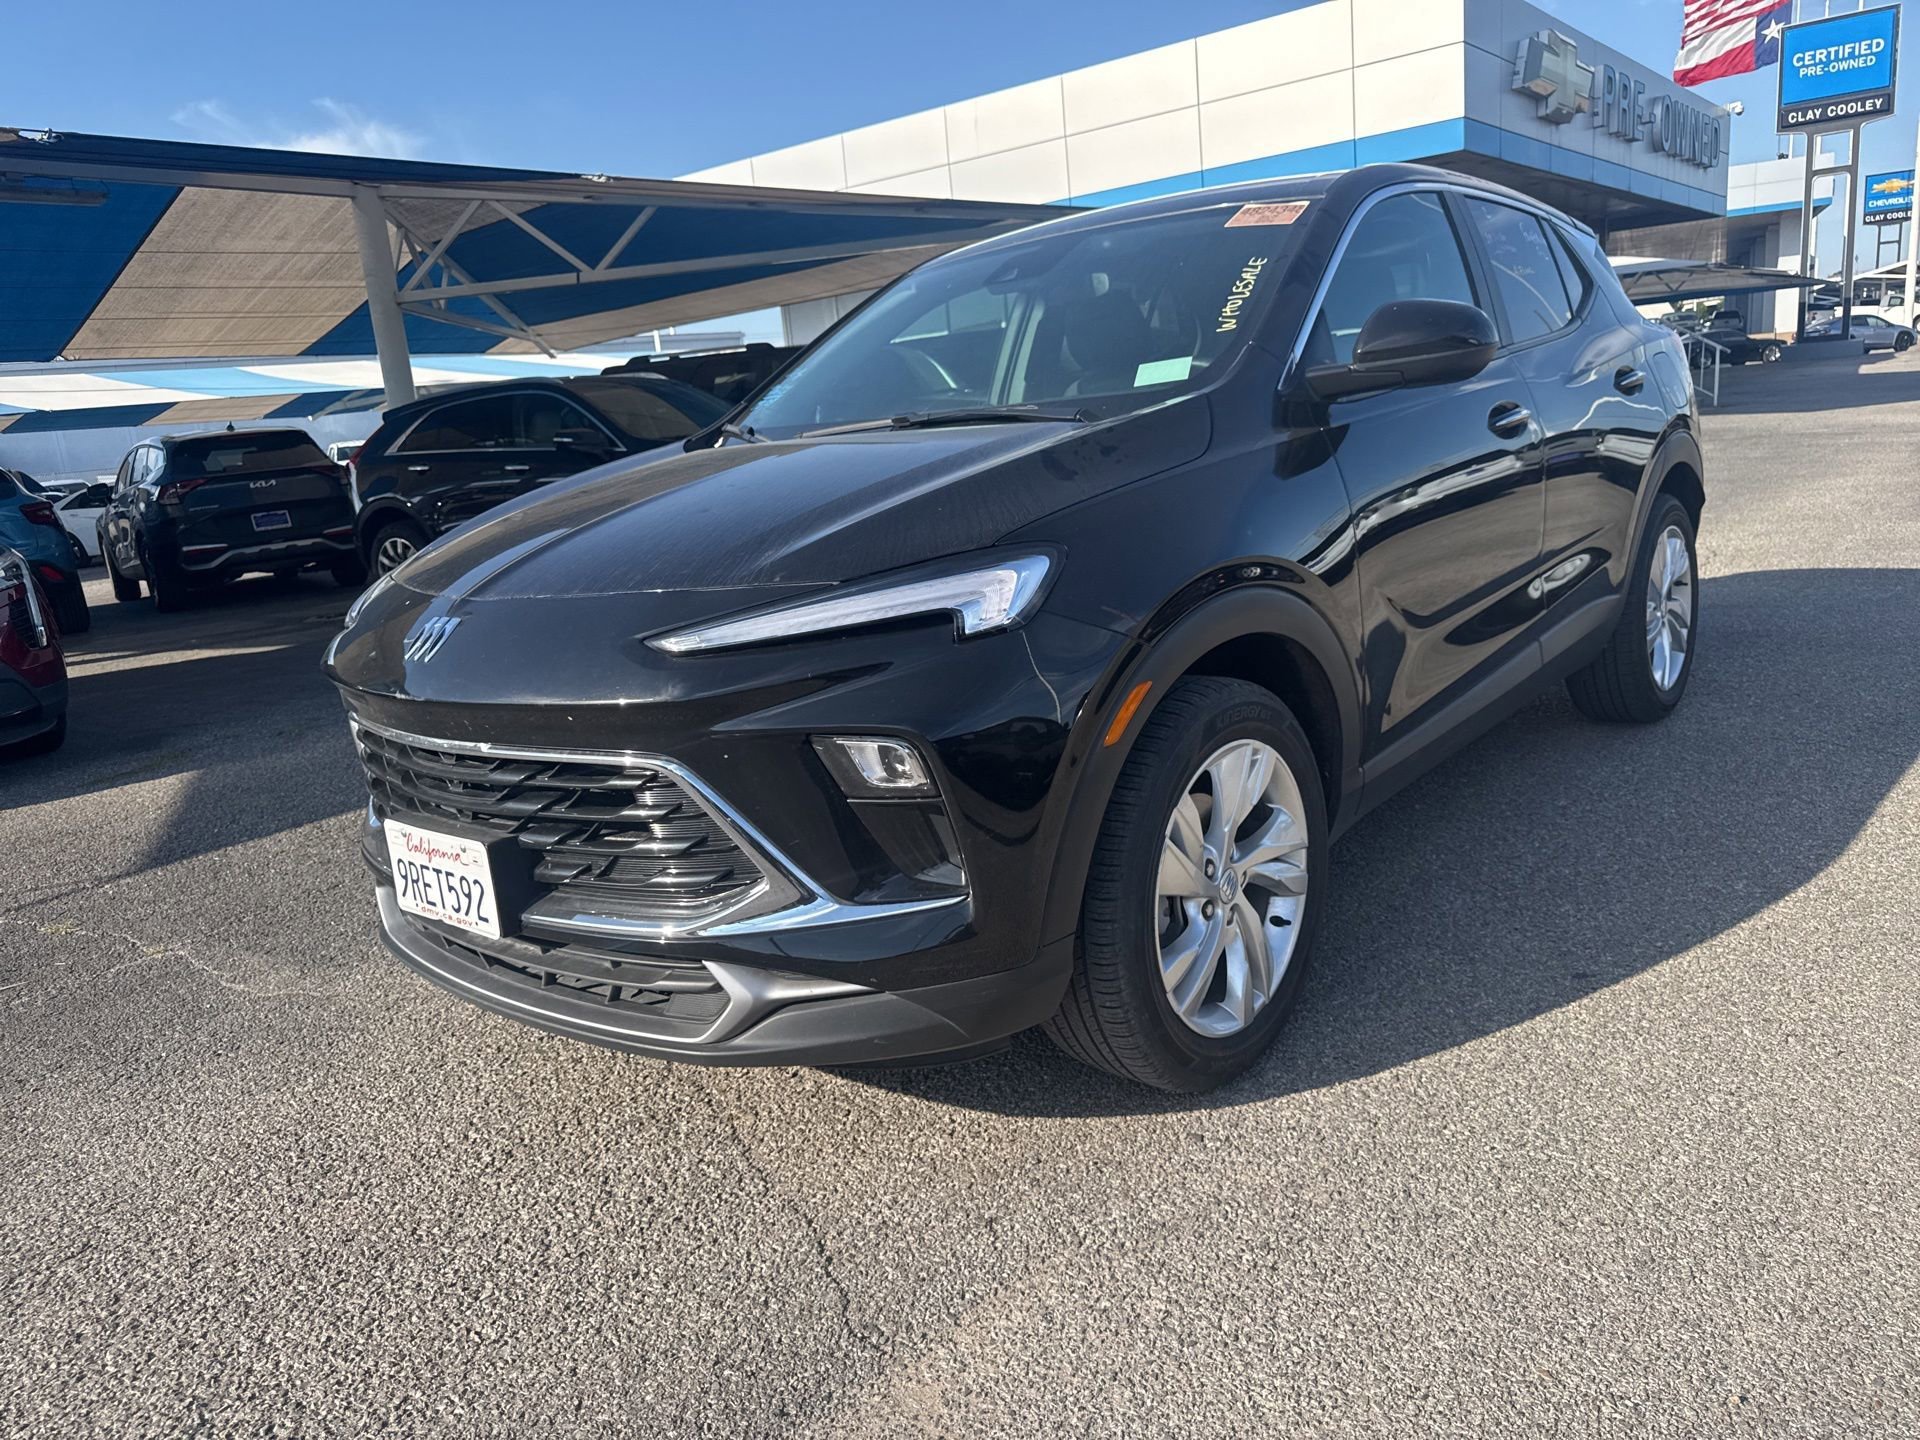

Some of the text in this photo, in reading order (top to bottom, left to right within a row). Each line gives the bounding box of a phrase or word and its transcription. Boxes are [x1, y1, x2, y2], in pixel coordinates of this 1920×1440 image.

[1792, 38, 1885, 67] CERTIFIED
[1799, 55, 1876, 78] PRE-OWNED
[1601, 64, 1720, 168] PRE-OWNED
[1788, 98, 1883, 123] CLAY COOLEY
[1865, 210, 1912, 222] CLAY COOLE
[1215, 256, 1268, 333] WHOLESALE
[406, 832, 470, 867] California
[397, 858, 489, 923] 9RET592
[421, 905, 473, 927] dmv.ca.gov
